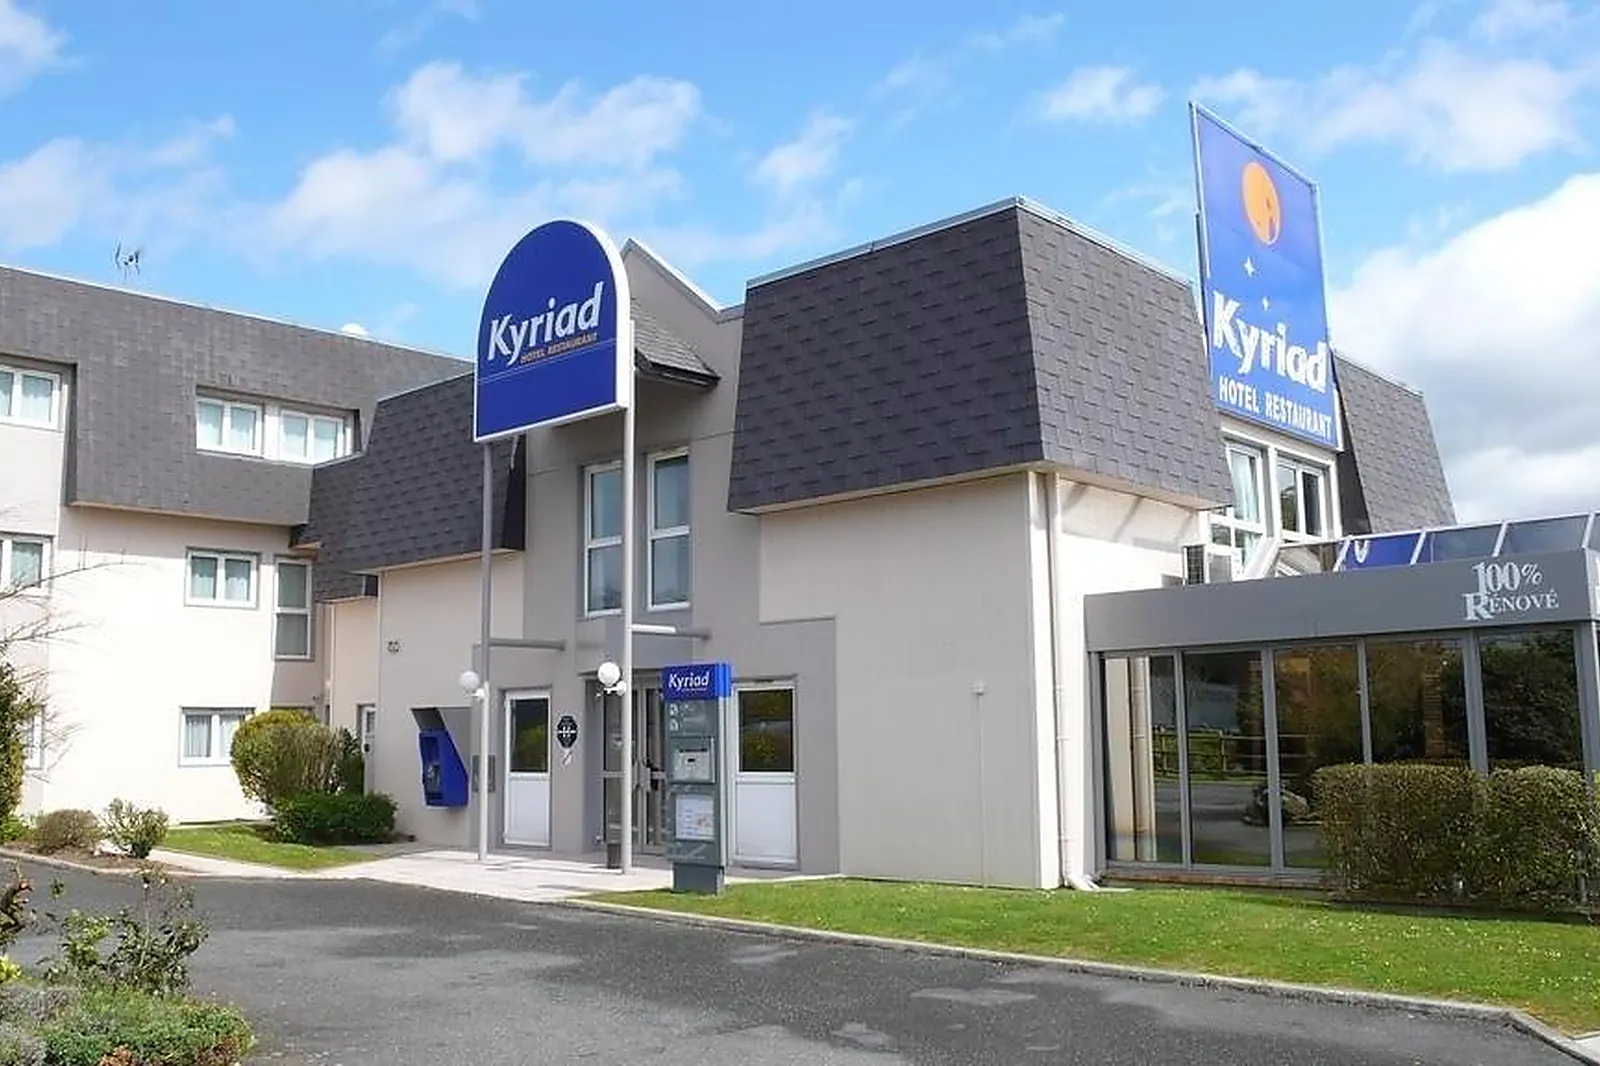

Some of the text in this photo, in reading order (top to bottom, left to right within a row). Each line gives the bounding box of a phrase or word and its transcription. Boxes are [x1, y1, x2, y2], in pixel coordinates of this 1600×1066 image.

[487, 281, 604, 366] Kyriad
[1213, 290, 1328, 393] Kyriad
[1219, 375, 1332, 440] HOTEL RESTAURANT
[1472, 561, 1543, 595] 100%
[668, 671, 709, 691] Kyriad
